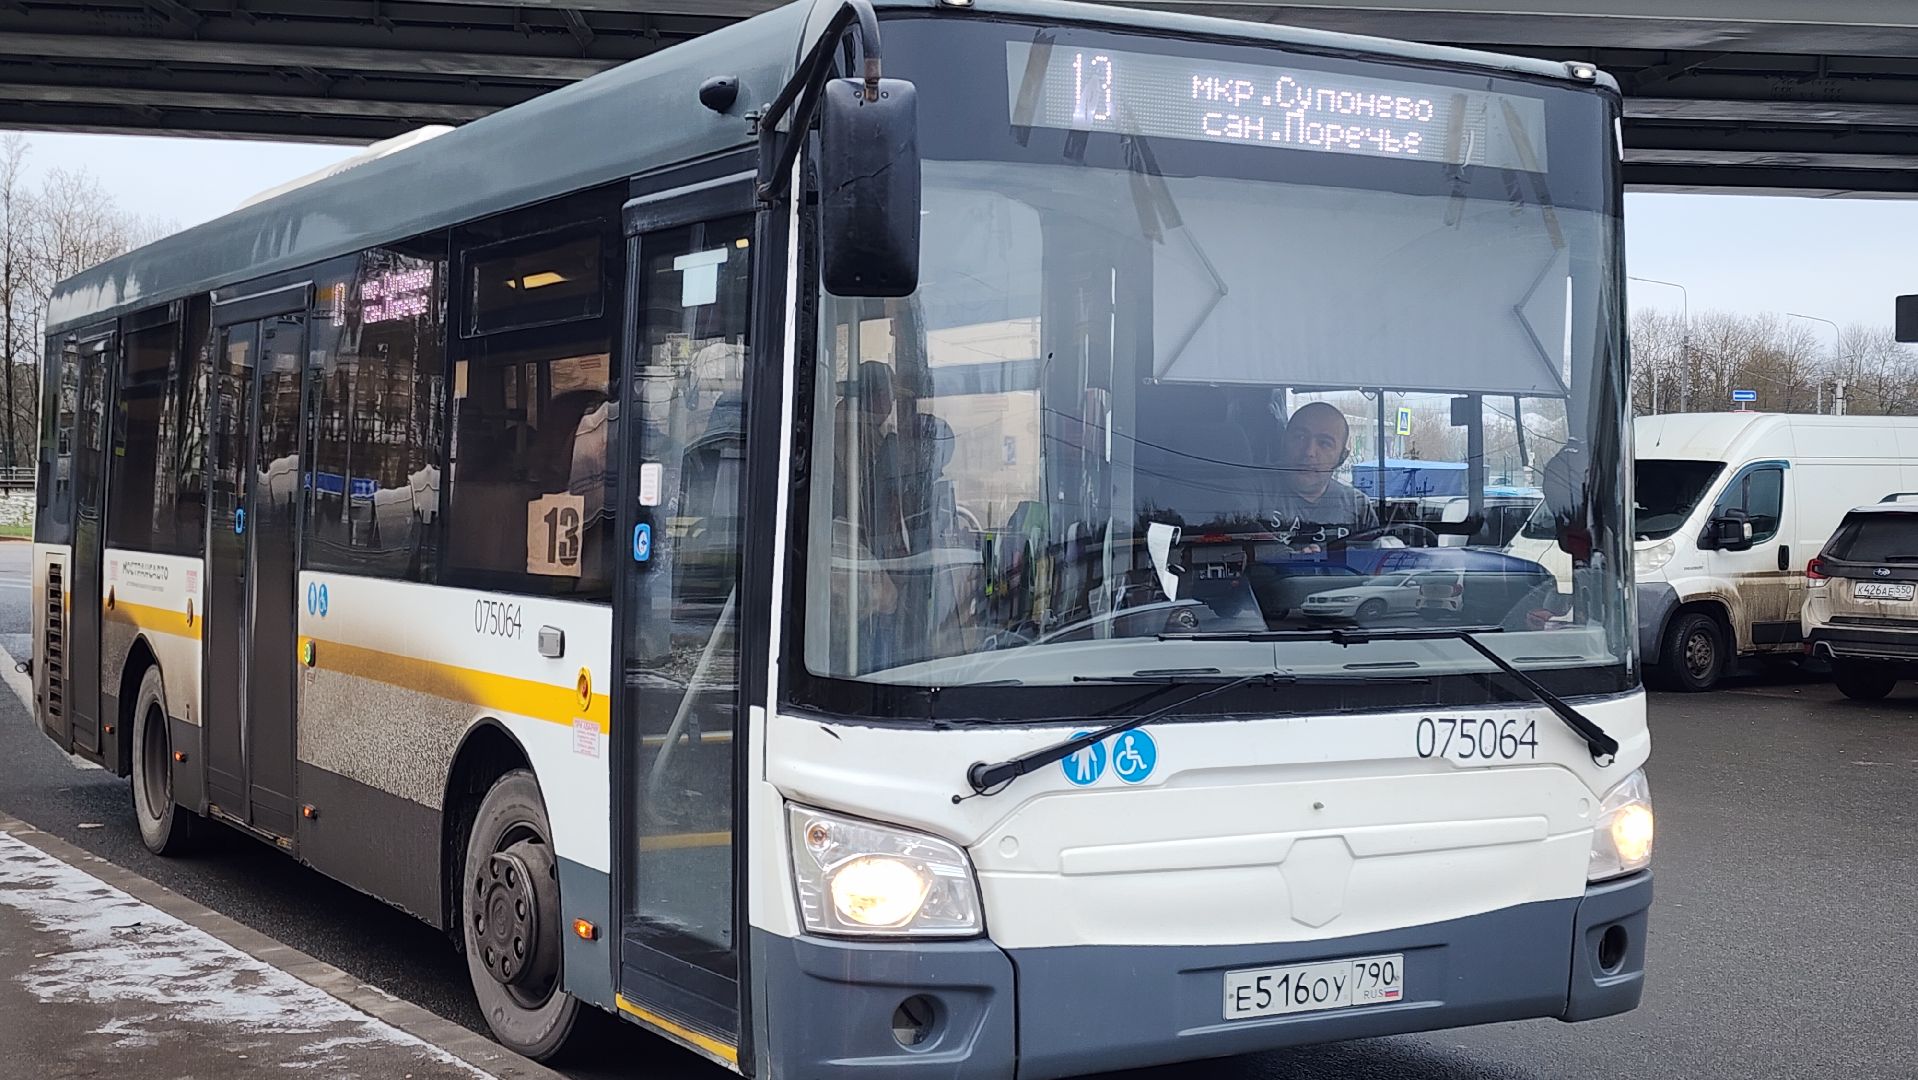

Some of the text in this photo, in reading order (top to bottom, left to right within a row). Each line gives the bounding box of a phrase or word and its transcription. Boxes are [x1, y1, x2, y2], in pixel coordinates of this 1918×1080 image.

[1073, 53, 1112, 120] 13
[1192, 75, 1433, 121] мкр.Супонево
[1202, 108, 1422, 153] сан.Поречье
[544, 507, 579, 566] 13
[1895, 586, 1912, 595] 550
[474, 599, 522, 640] 075064
[1416, 717, 1539, 759] 075064
[1236, 961, 1395, 1012] Е516ОУ 790
[1363, 989, 1384, 1000] RUS
